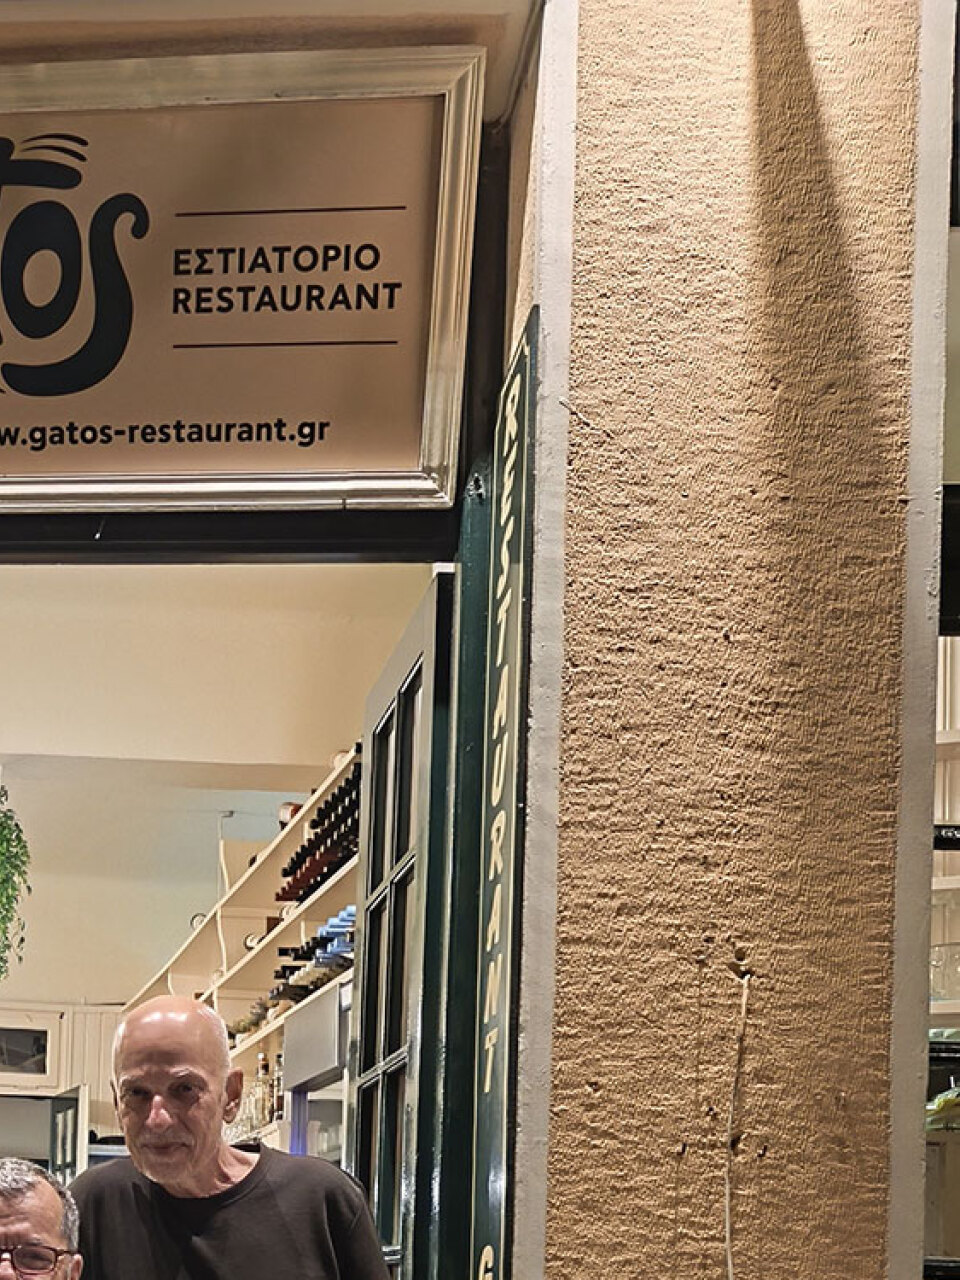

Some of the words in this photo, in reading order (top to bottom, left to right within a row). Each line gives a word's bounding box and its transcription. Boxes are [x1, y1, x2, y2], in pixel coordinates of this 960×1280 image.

[172, 244, 381, 276] ΕΣΤΙΑΤΟΡΙΟ
[172, 284, 402, 314] RESTAURANT
[485, 373, 522, 1093] RESTAURANT
